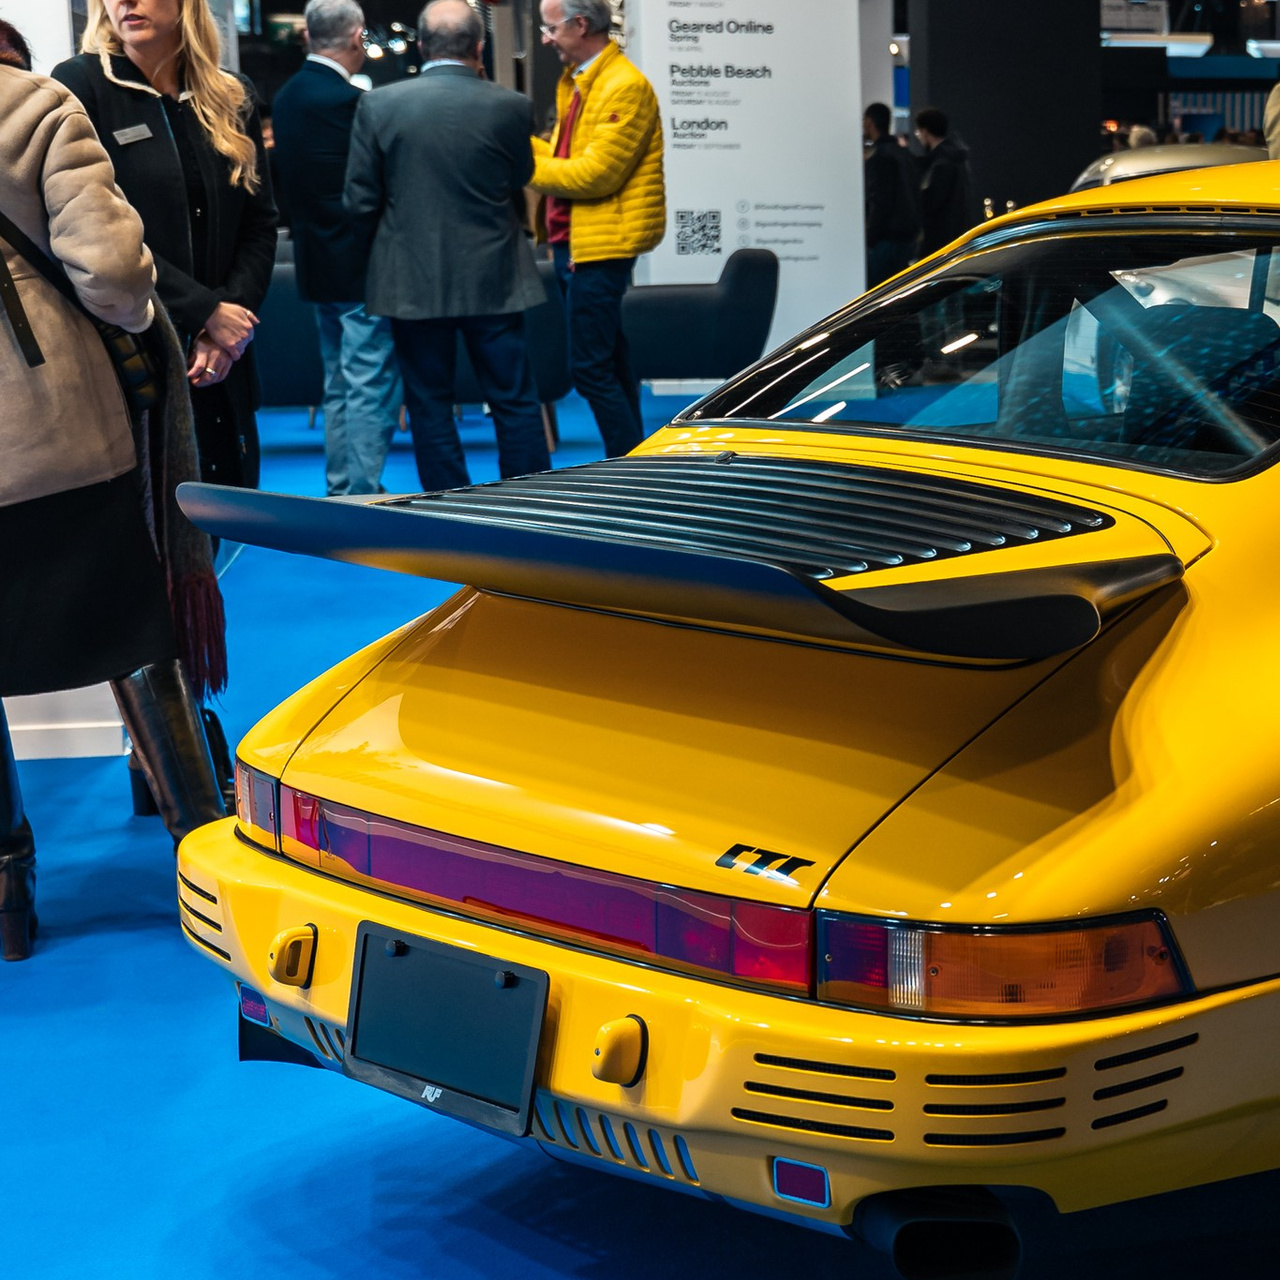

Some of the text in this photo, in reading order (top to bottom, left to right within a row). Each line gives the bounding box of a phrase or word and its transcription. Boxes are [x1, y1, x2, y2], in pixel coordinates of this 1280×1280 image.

[668, 19, 775, 34] Geared Online
[670, 64, 772, 79] Pebble Beach
[671, 116, 728, 131] London
